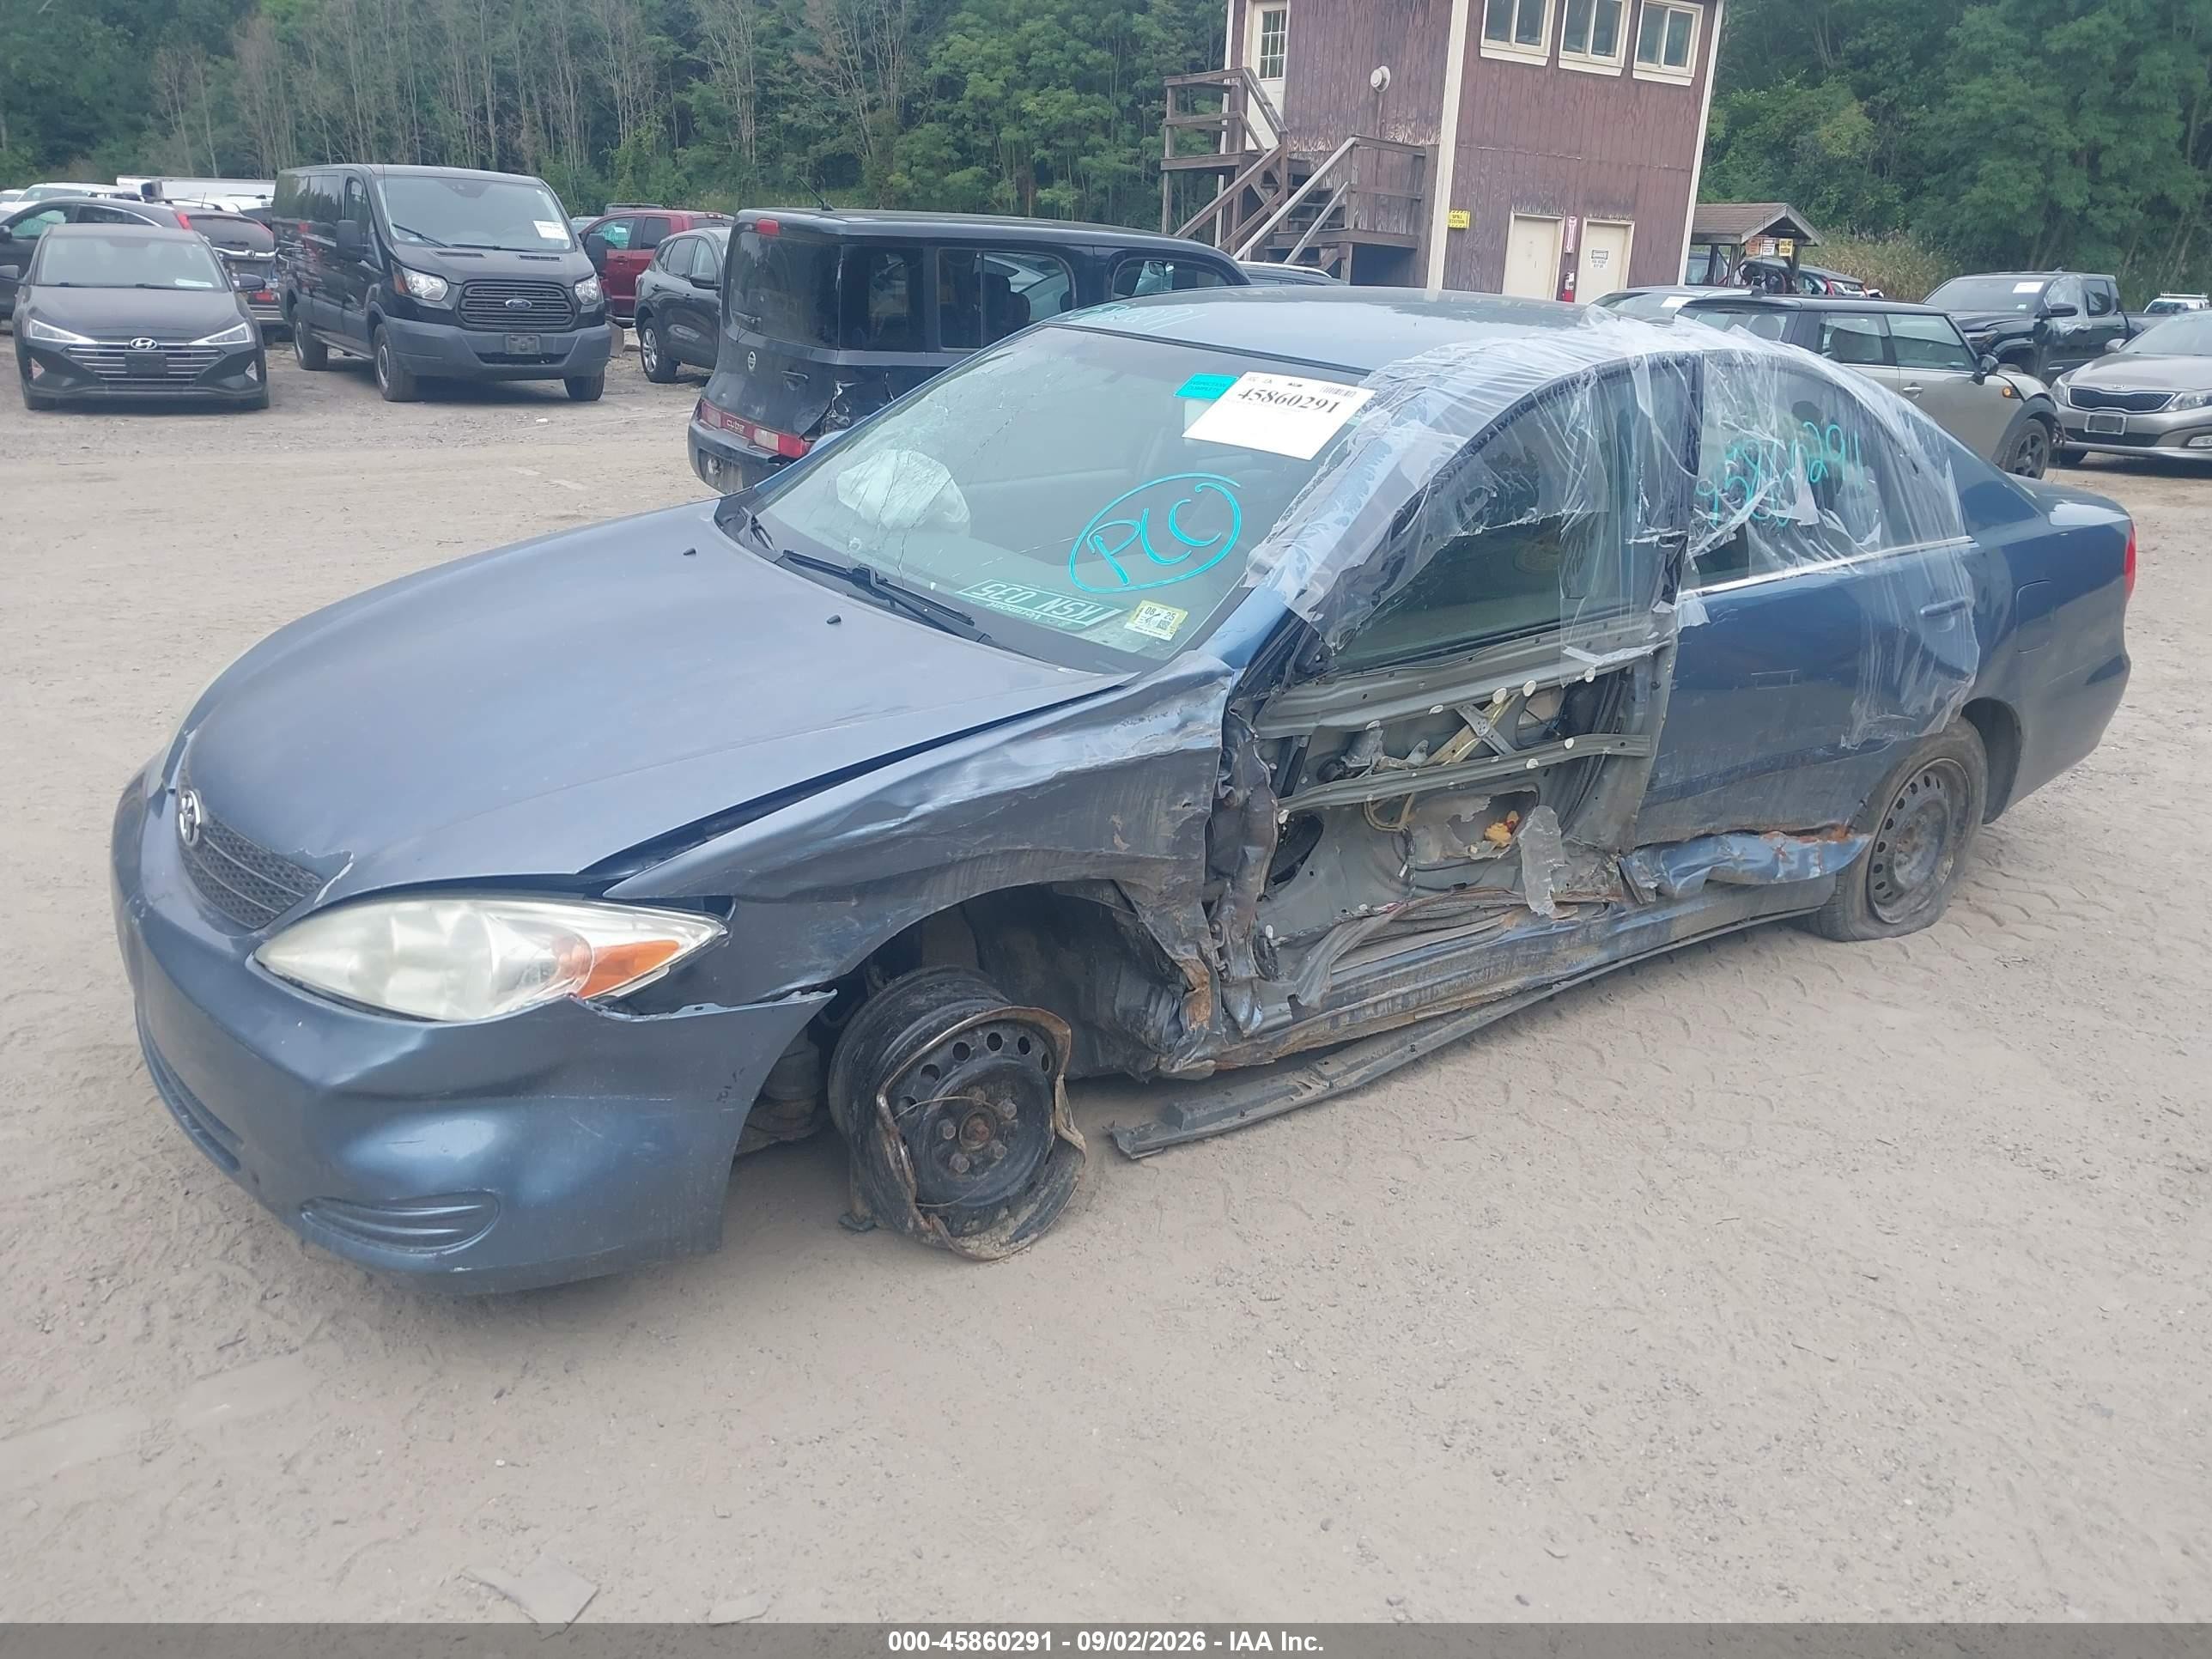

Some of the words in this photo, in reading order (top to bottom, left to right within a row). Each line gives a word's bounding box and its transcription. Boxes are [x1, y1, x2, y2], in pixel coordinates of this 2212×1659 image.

[1237, 387, 1341, 413] 45860291
[971, 583, 1038, 604] 035
[986, 602, 1042, 620] Vermont
[1034, 598, 1104, 620] KSN
[1145, 606, 1157, 616] 08
[1164, 611, 1176, 621] 25
